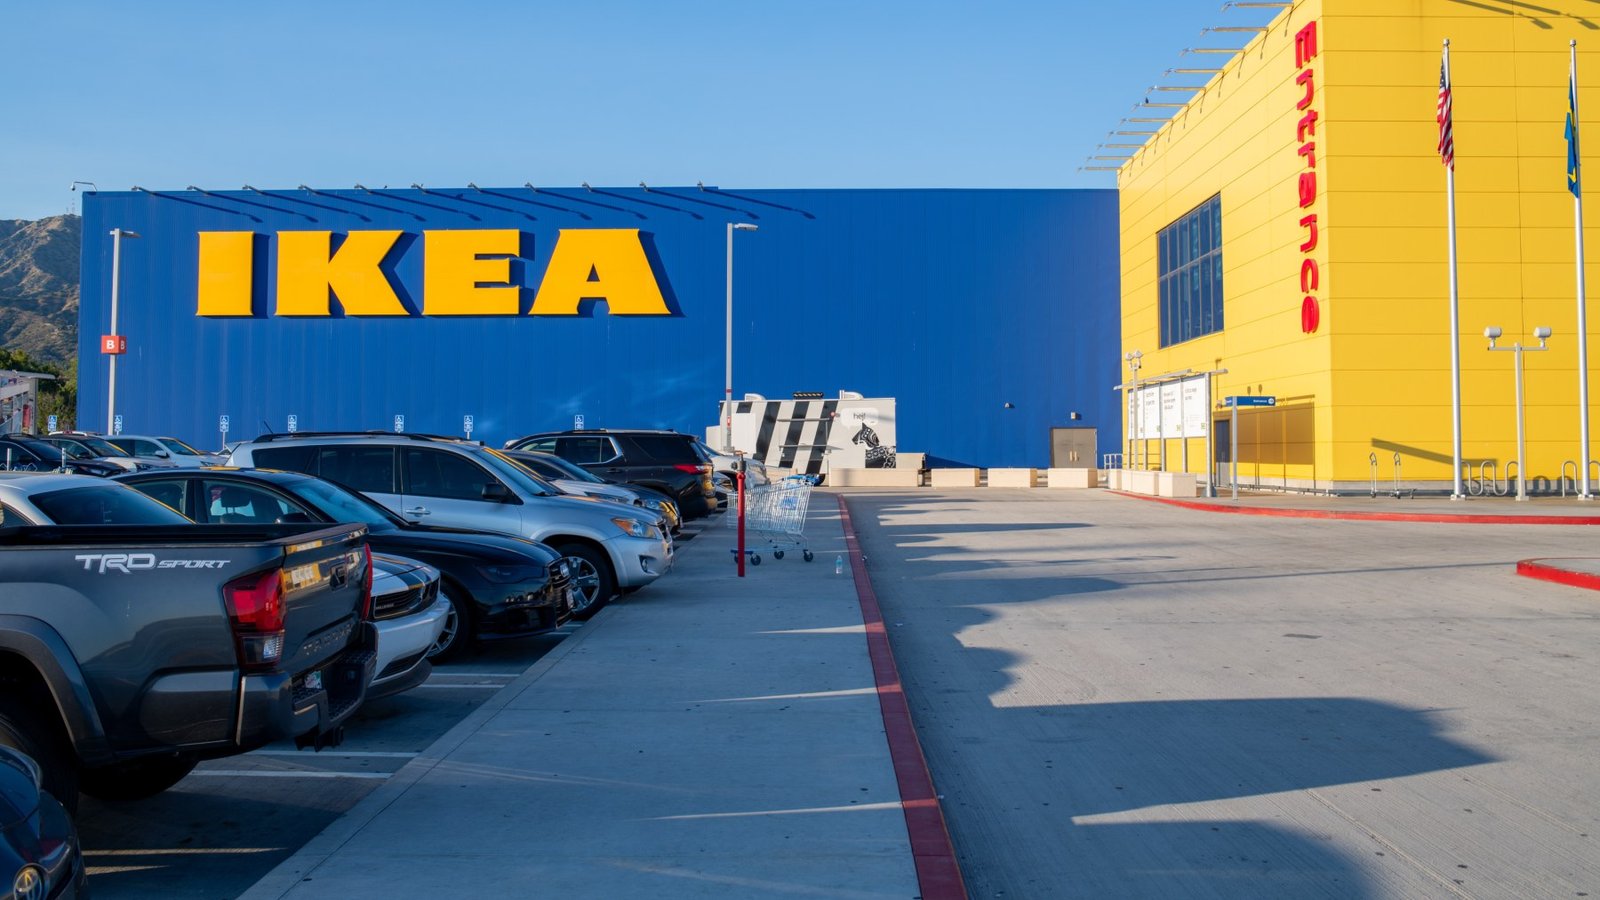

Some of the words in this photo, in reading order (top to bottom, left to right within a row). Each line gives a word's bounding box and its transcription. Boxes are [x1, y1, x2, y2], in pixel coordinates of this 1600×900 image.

[1295, 21, 1320, 334] Entrance
[196, 228, 671, 317] IKEA
[106, 340, 115, 350] B
[75, 553, 156, 574] TRD
[157, 559, 231, 569] SPORT
